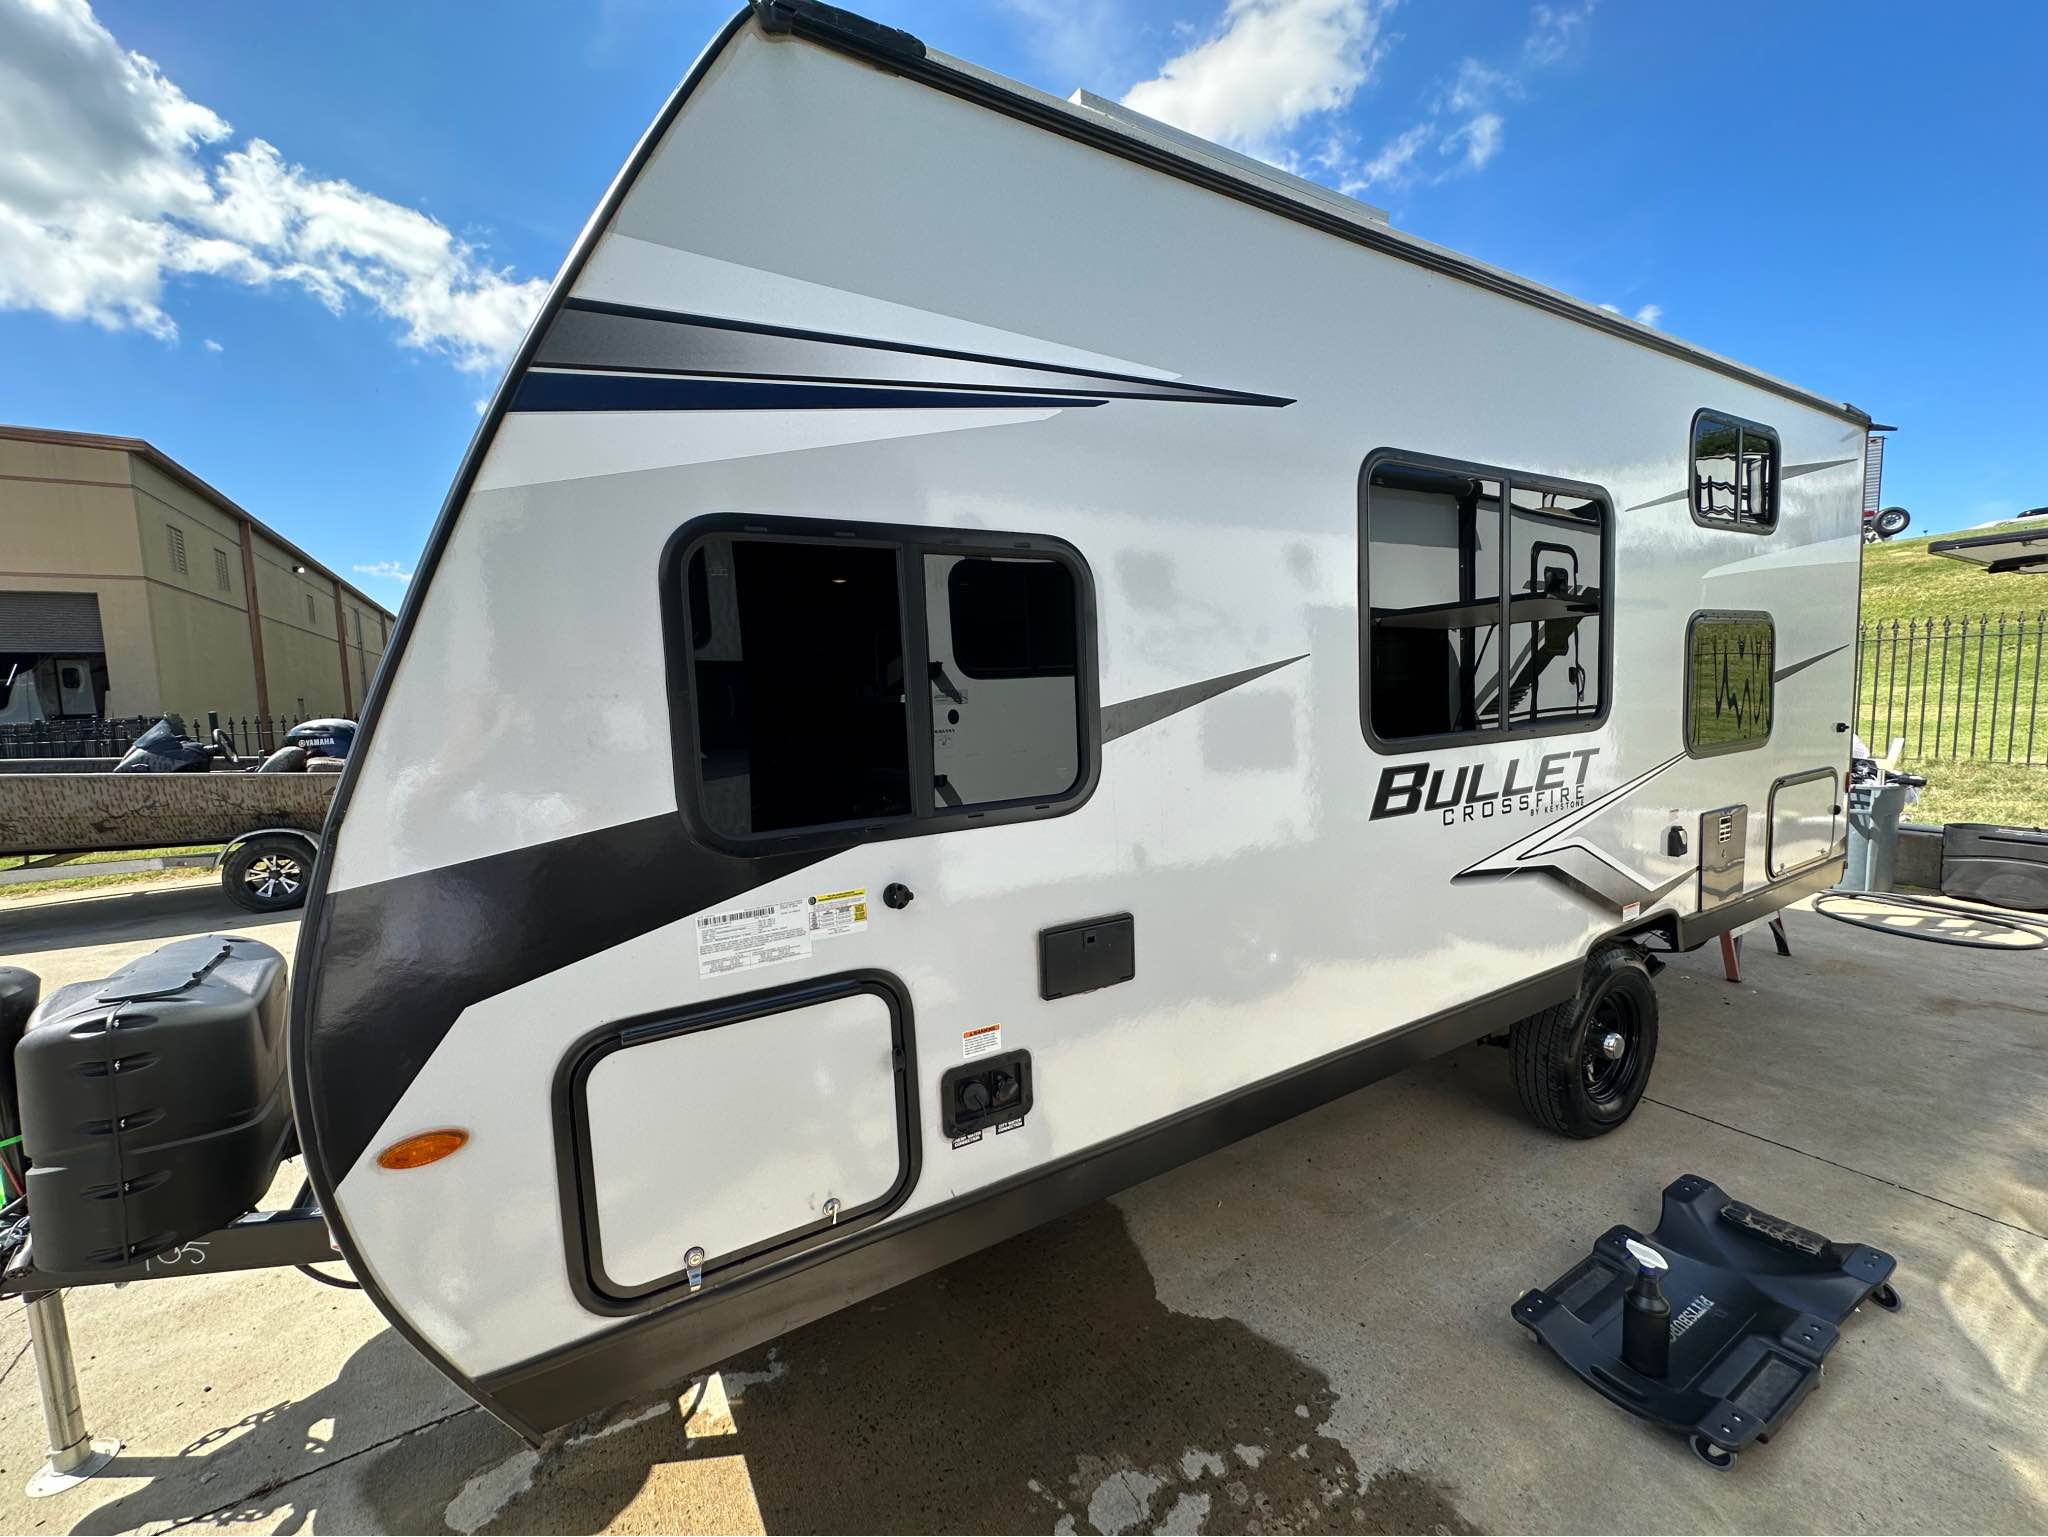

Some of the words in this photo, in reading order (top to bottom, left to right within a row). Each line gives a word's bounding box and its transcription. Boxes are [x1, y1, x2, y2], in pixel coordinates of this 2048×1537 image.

[306, 737, 335, 747] YAMAHA
[1369, 748, 1600, 821] BULLET
[1443, 784, 1584, 826] CROSSFIRE
[1530, 808, 1539, 817] BY
[1544, 799, 1585, 813] KEYSTONE
[1670, 1294, 1715, 1343] PITTSBUR
